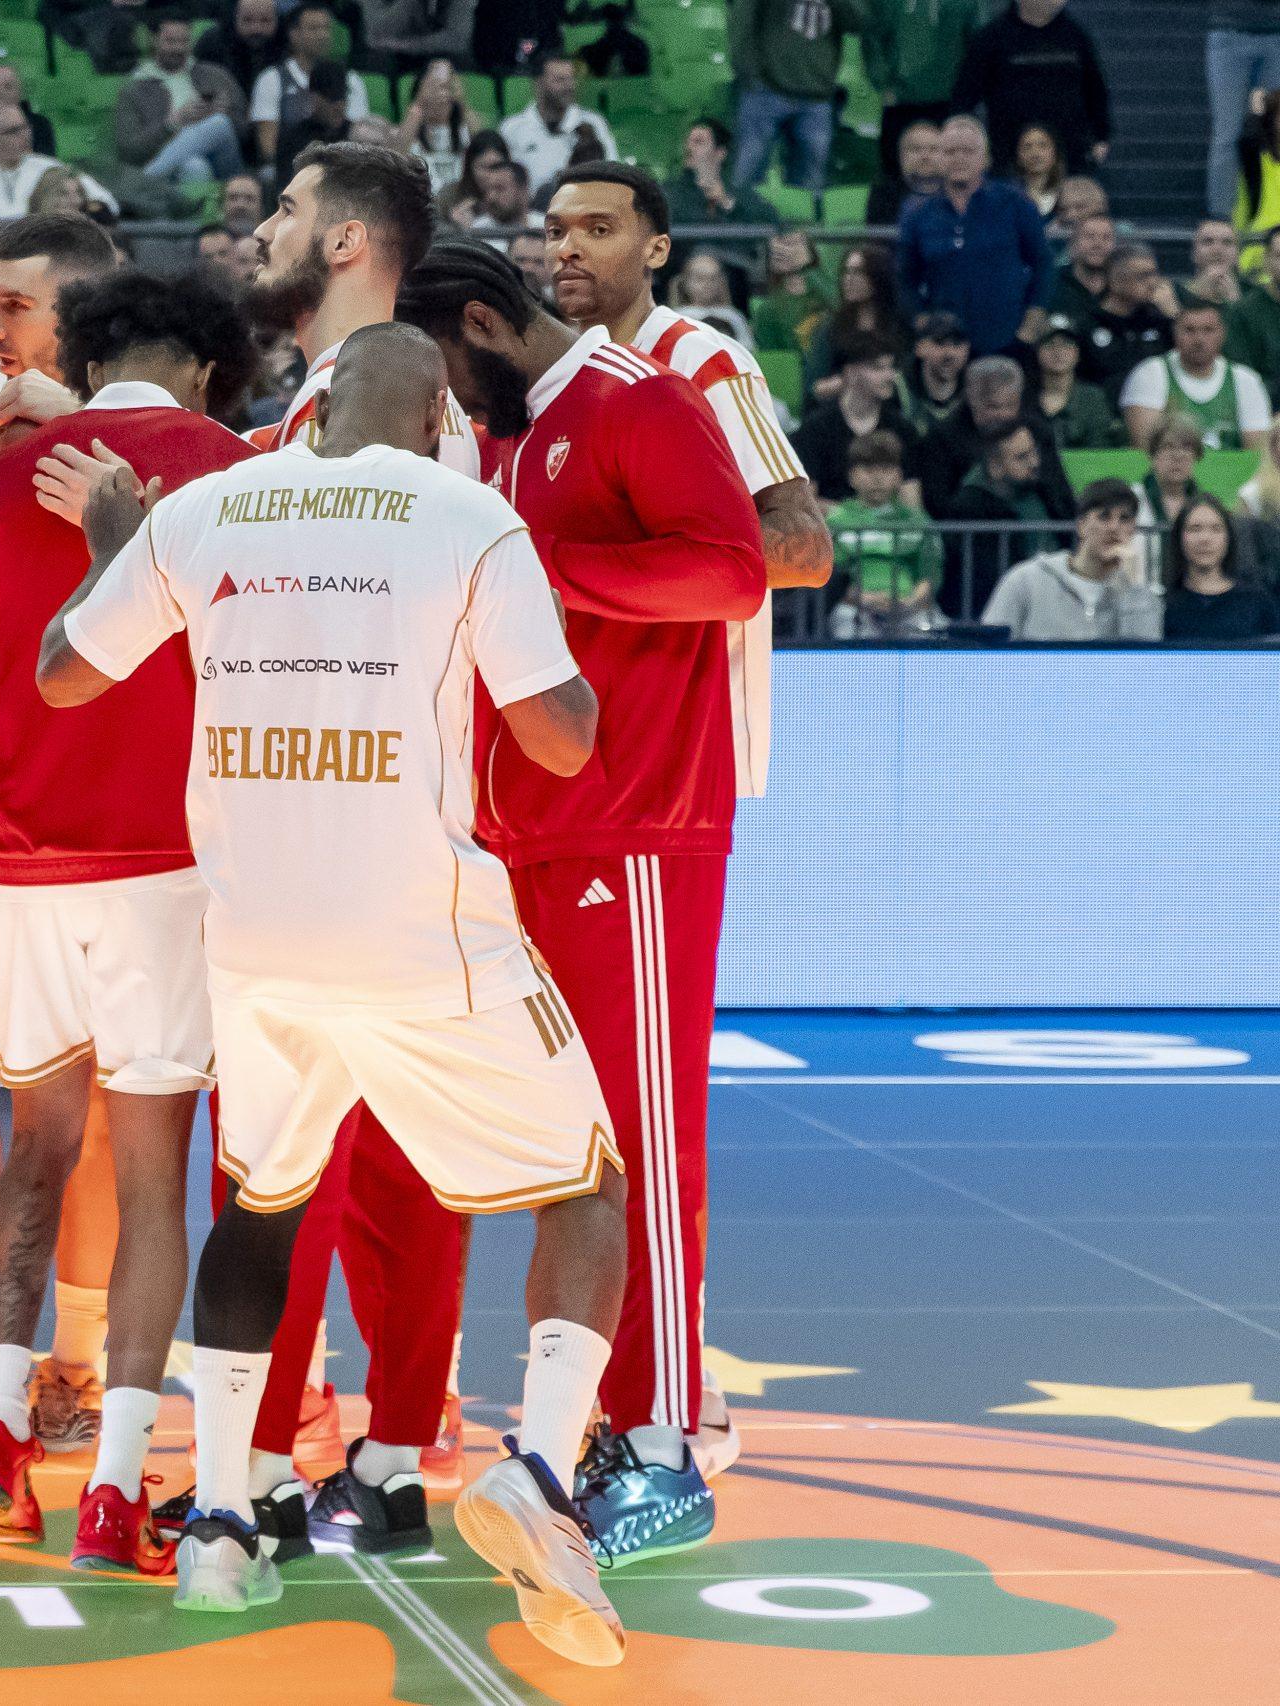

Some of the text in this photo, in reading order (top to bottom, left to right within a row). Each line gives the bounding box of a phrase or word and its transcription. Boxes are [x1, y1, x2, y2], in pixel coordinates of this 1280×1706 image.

[217, 487, 417, 527] MILLER-MCINTYRE
[221, 659, 399, 676] W.D. CONCORD WEST
[205, 726, 403, 783] BELGRADE
